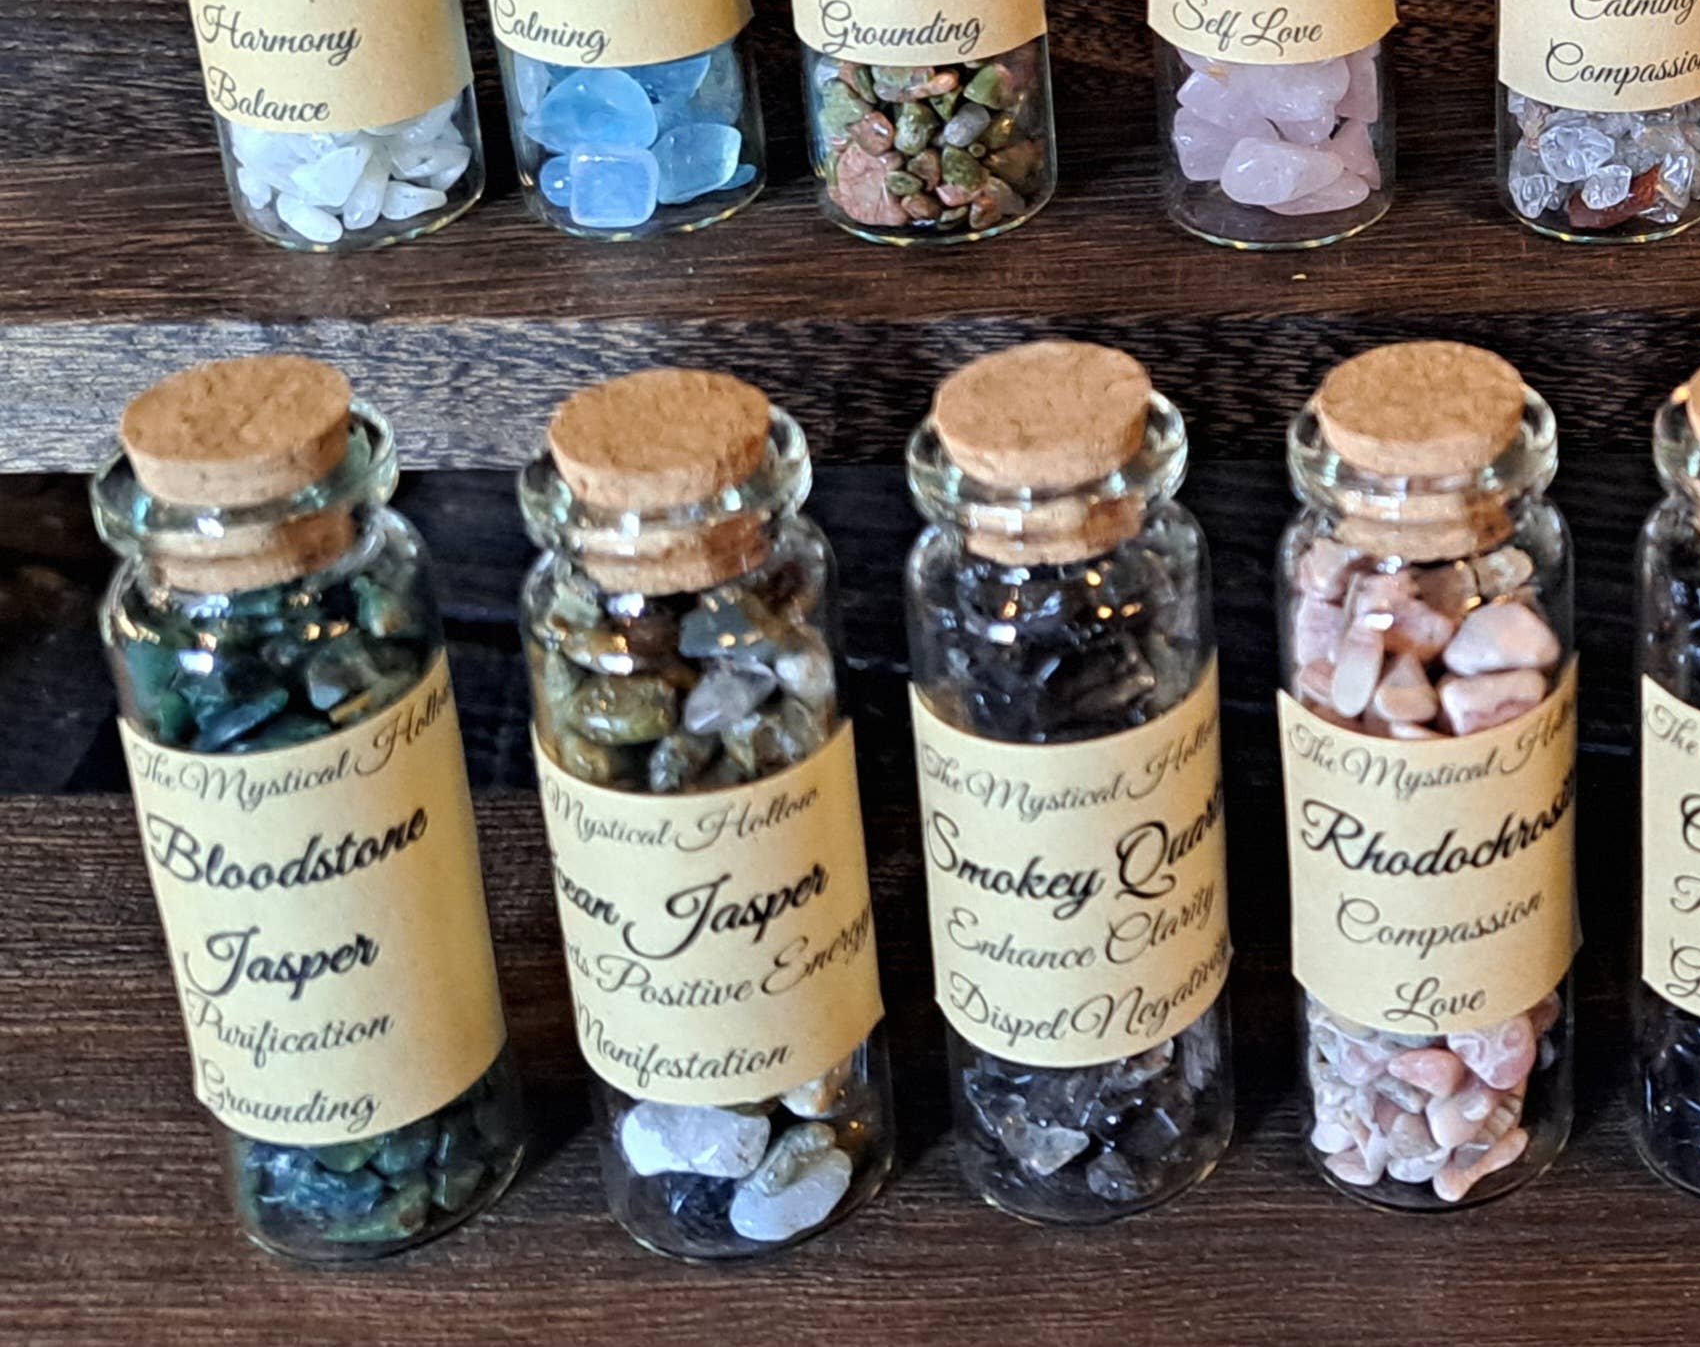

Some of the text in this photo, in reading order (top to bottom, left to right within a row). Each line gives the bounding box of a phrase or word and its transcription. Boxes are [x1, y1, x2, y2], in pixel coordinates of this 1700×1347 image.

[198, 4, 362, 66] Harmony
[1241, 11, 1323, 57] Love
[207, 66, 330, 123] Balance
[180, 750, 353, 811] Mystical
[966, 768, 1125, 821] Mystical
[1341, 746, 1500, 802] Mystical
[147, 807, 428, 891] Bloodstone
[675, 786, 819, 853] Hollow
[926, 812, 1104, 921] Smokey
[622, 862, 829, 961] Jasper
[946, 880, 1217, 971] Enhance Clarity
[1336, 890, 1544, 960] Compassion
[183, 926, 380, 1001] Jasper
[596, 953, 754, 1007] Positive
[185, 987, 394, 1068] Purification
[949, 971, 1068, 1048] Dispel
[1382, 977, 1487, 1031] Love
